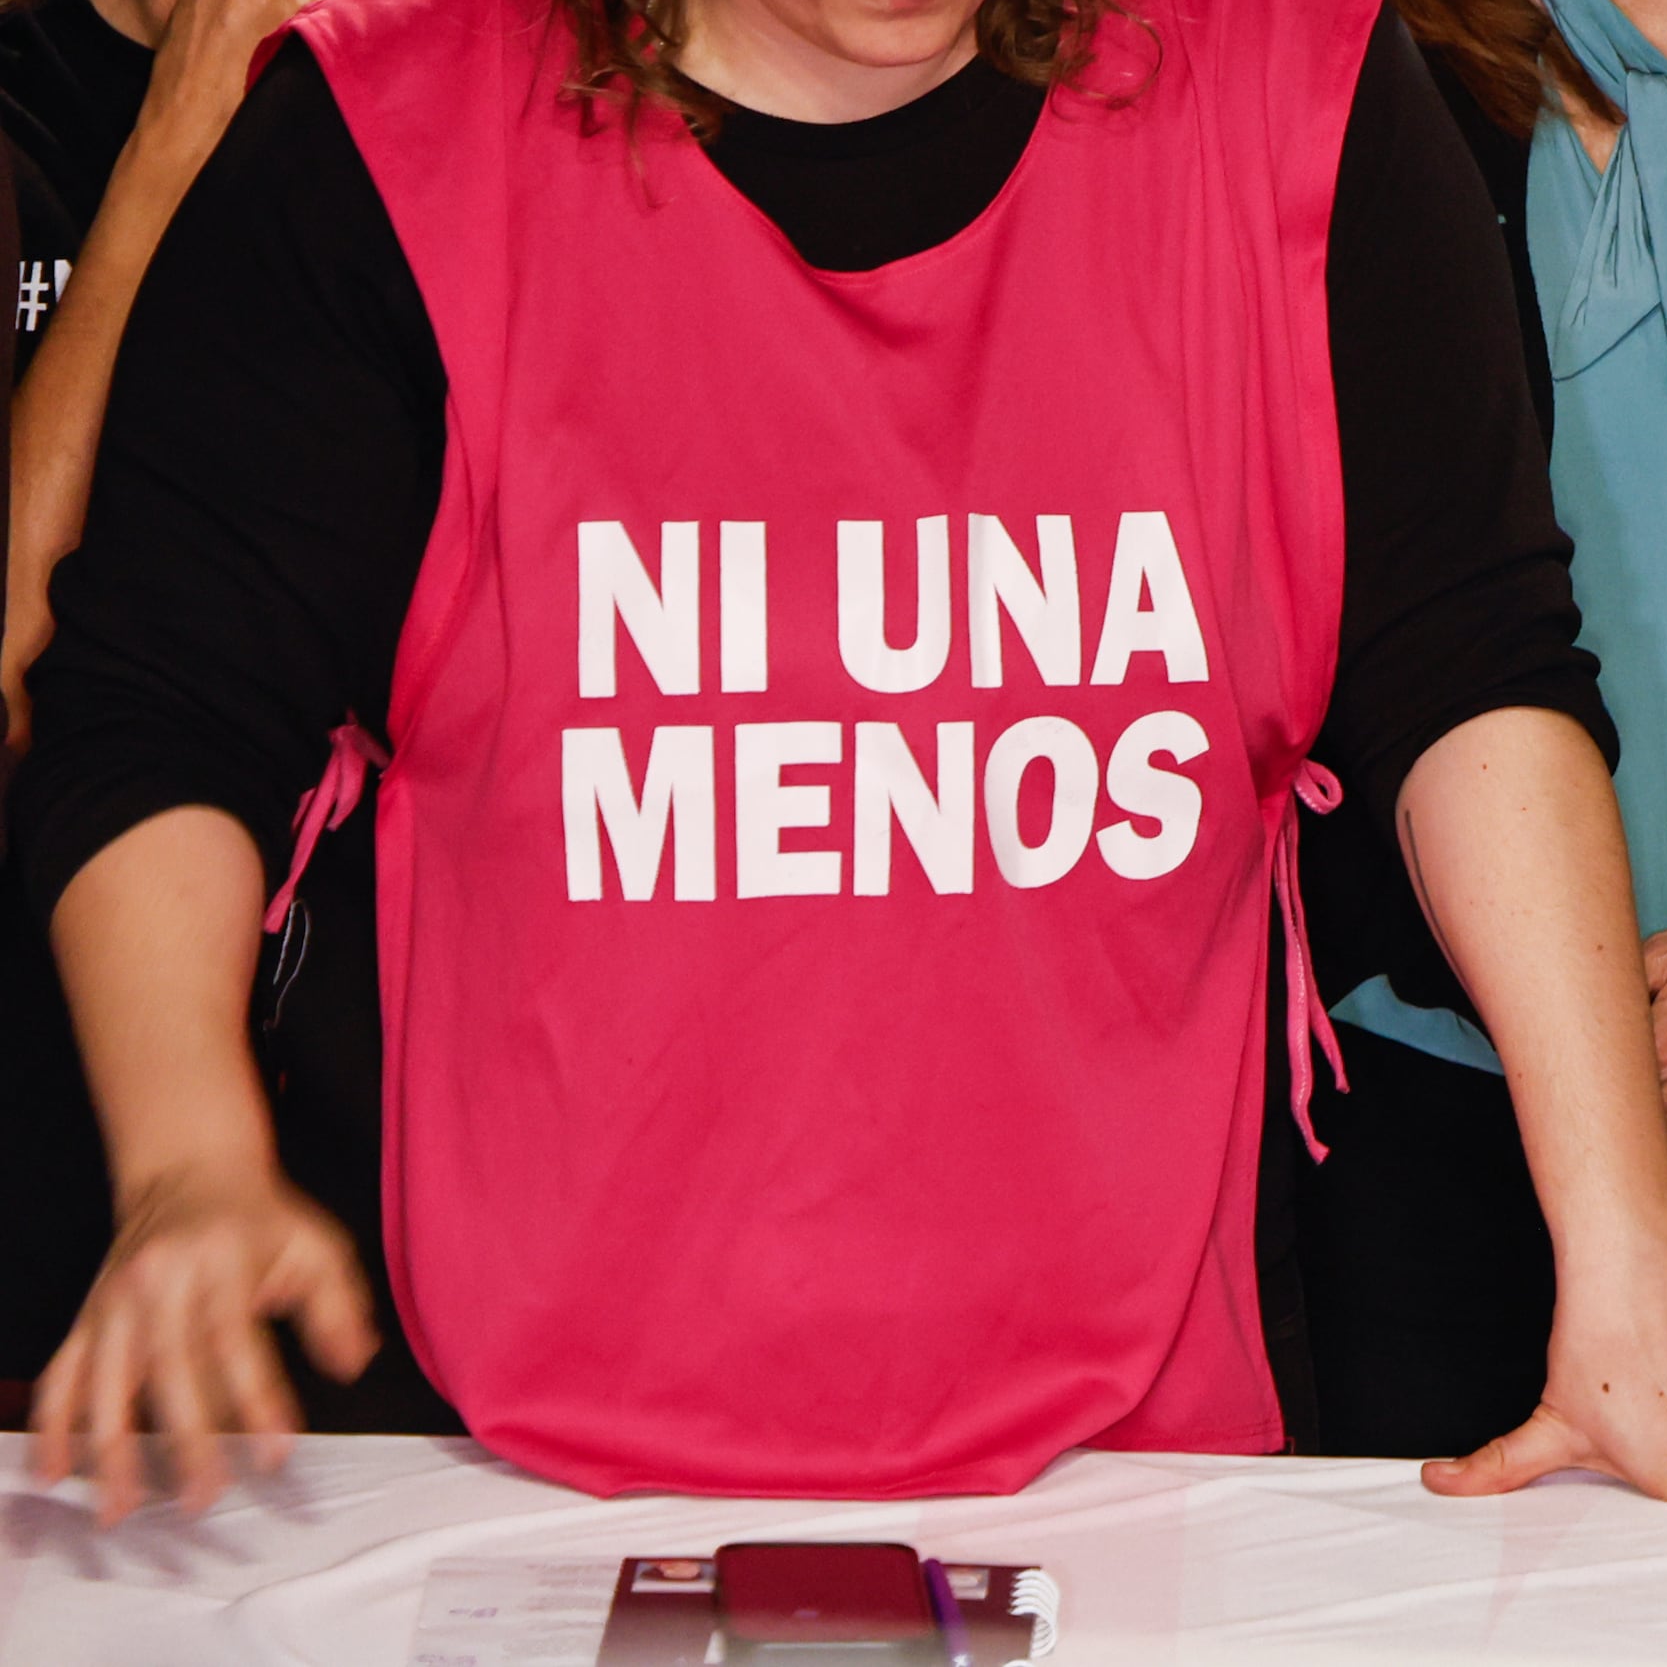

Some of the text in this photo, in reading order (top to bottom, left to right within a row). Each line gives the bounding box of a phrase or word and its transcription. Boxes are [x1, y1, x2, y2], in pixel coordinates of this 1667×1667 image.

[577, 510, 1210, 698] NI UNA
[561, 709, 1210, 902] MENOS
